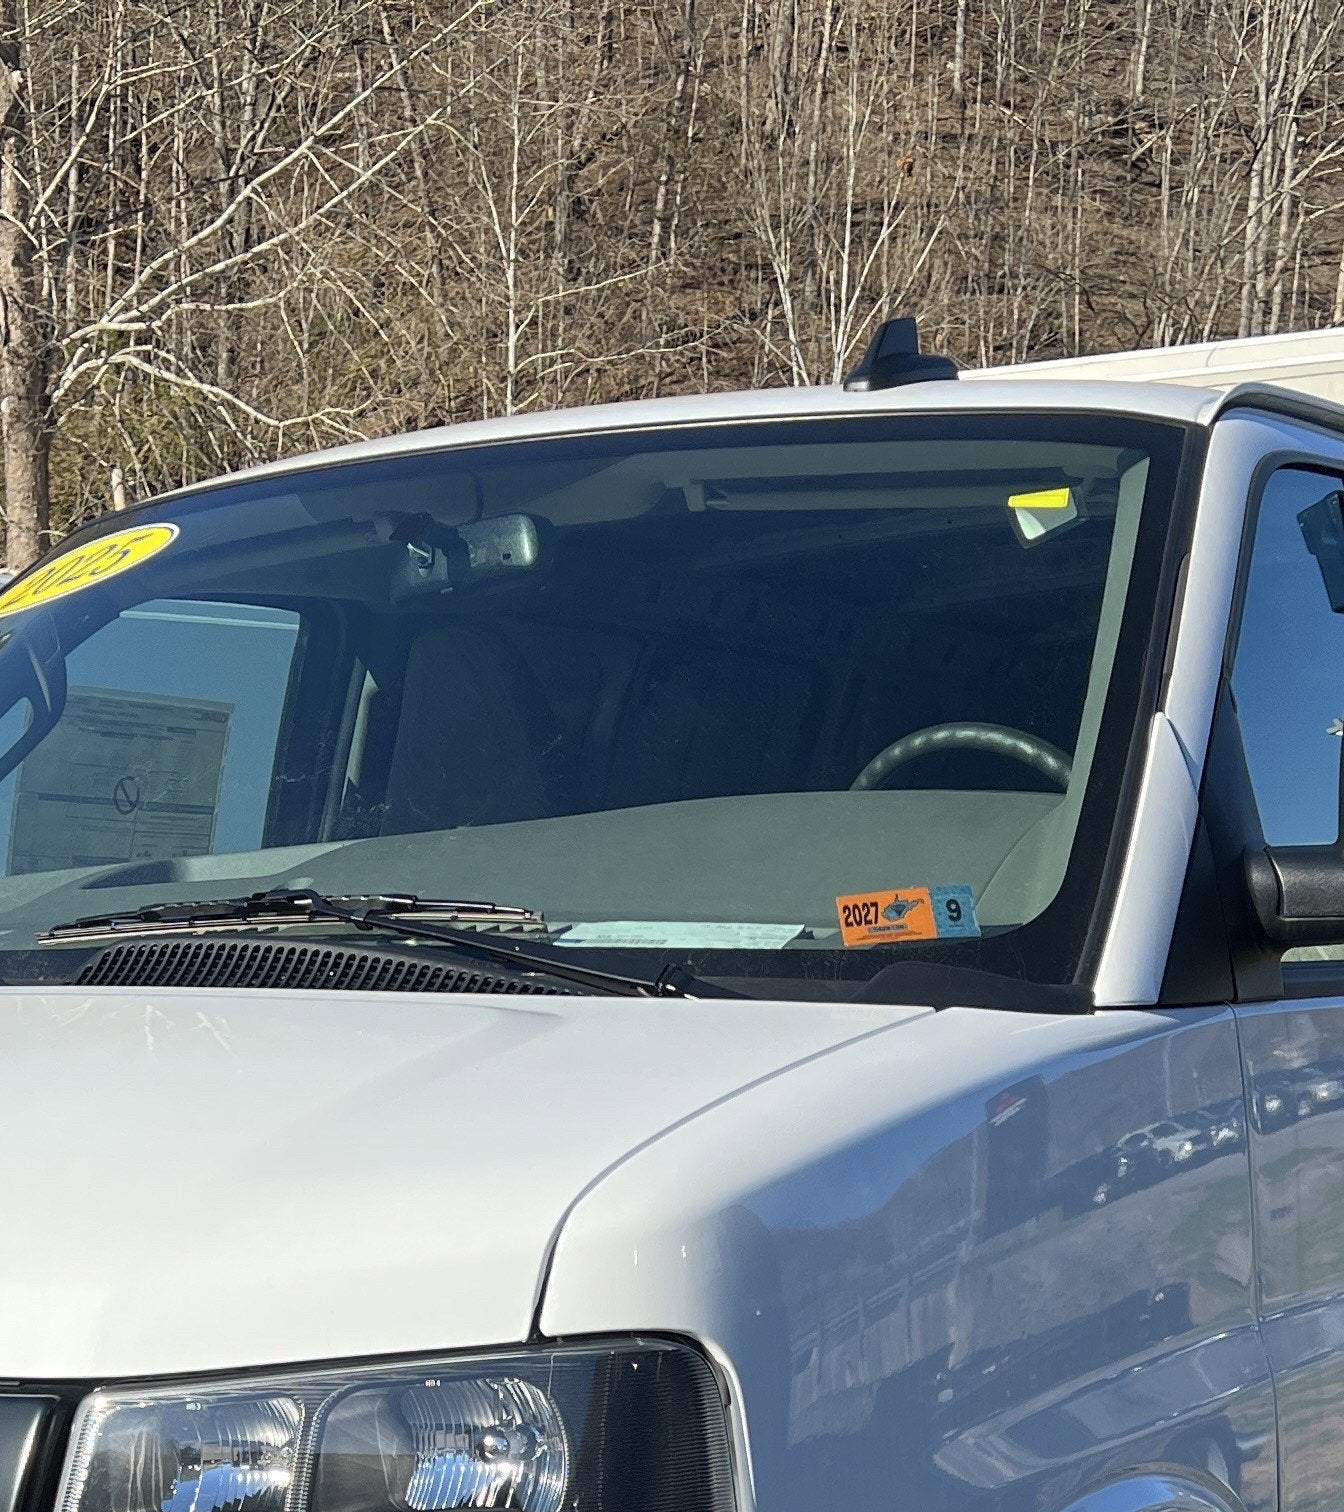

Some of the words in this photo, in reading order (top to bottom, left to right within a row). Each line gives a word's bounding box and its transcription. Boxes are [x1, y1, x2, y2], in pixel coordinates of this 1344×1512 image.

[0, 532, 154, 612] 2025
[842, 901, 879, 927] 2027
[945, 898, 962, 922] 9
